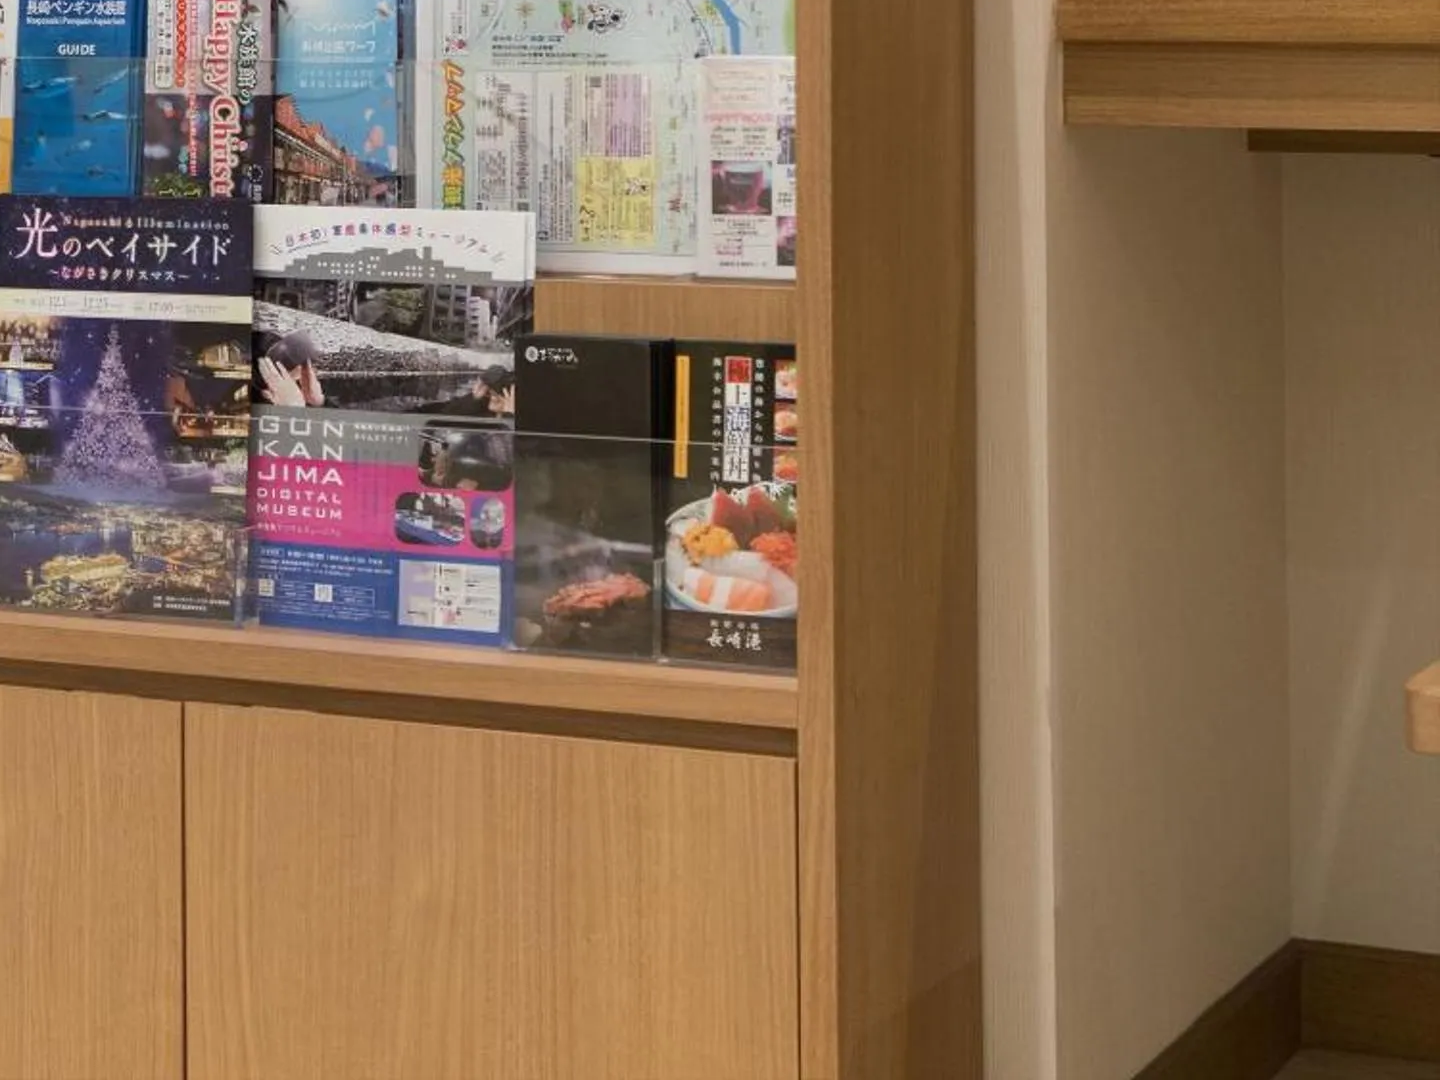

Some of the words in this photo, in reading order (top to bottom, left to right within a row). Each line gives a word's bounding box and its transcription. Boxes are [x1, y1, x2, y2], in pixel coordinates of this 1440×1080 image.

[57, 44, 97, 57] GUIDE
[15, 207, 235, 266] 光のベイサイド
[259, 415, 344, 440] GUN
[258, 439, 344, 462] KAN
[257, 463, 344, 487] JIMA
[257, 486, 342, 505] DIGITAL
[256, 502, 343, 521] MUSEUM
